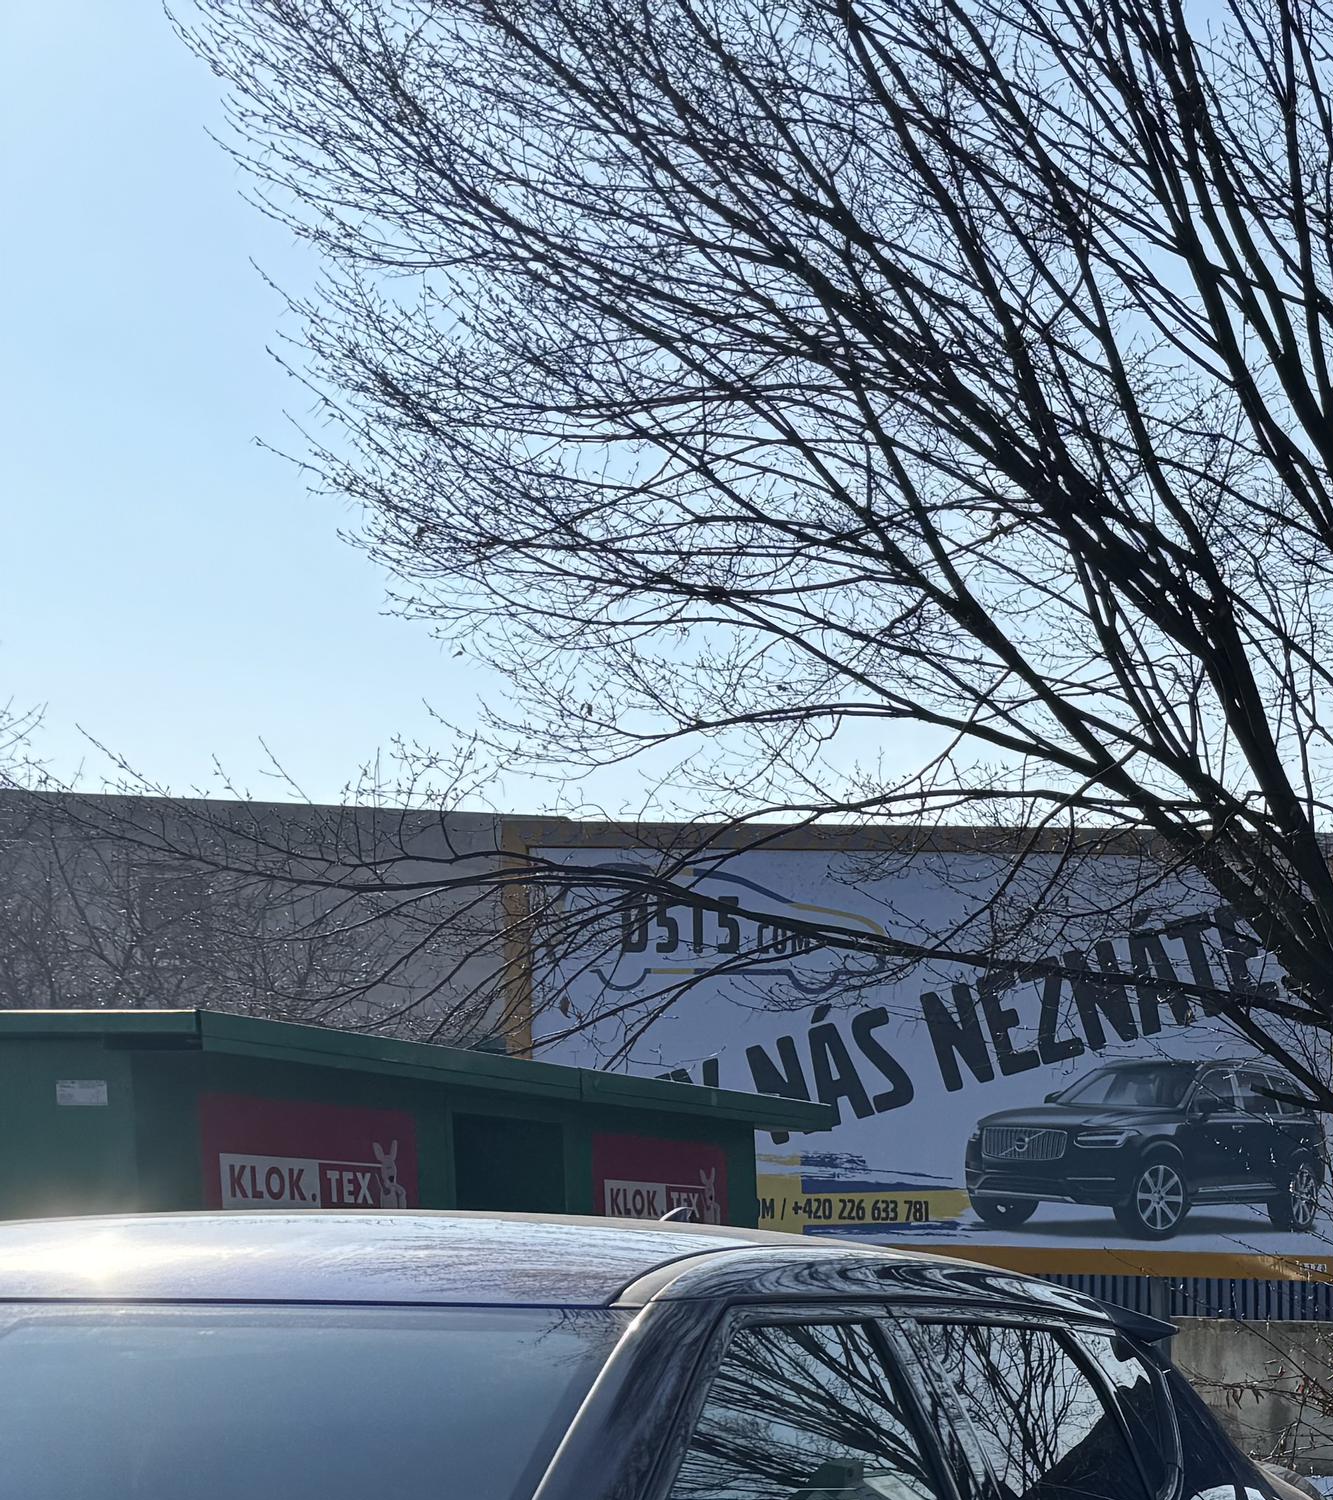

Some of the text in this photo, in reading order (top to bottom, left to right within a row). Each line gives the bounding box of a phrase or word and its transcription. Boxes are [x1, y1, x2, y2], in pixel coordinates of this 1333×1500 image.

[791, 1199, 833, 1221] +420
[838, 1199, 866, 1221] 226
[871, 1200, 898, 1222] 633
[904, 1200, 929, 1222] 781
